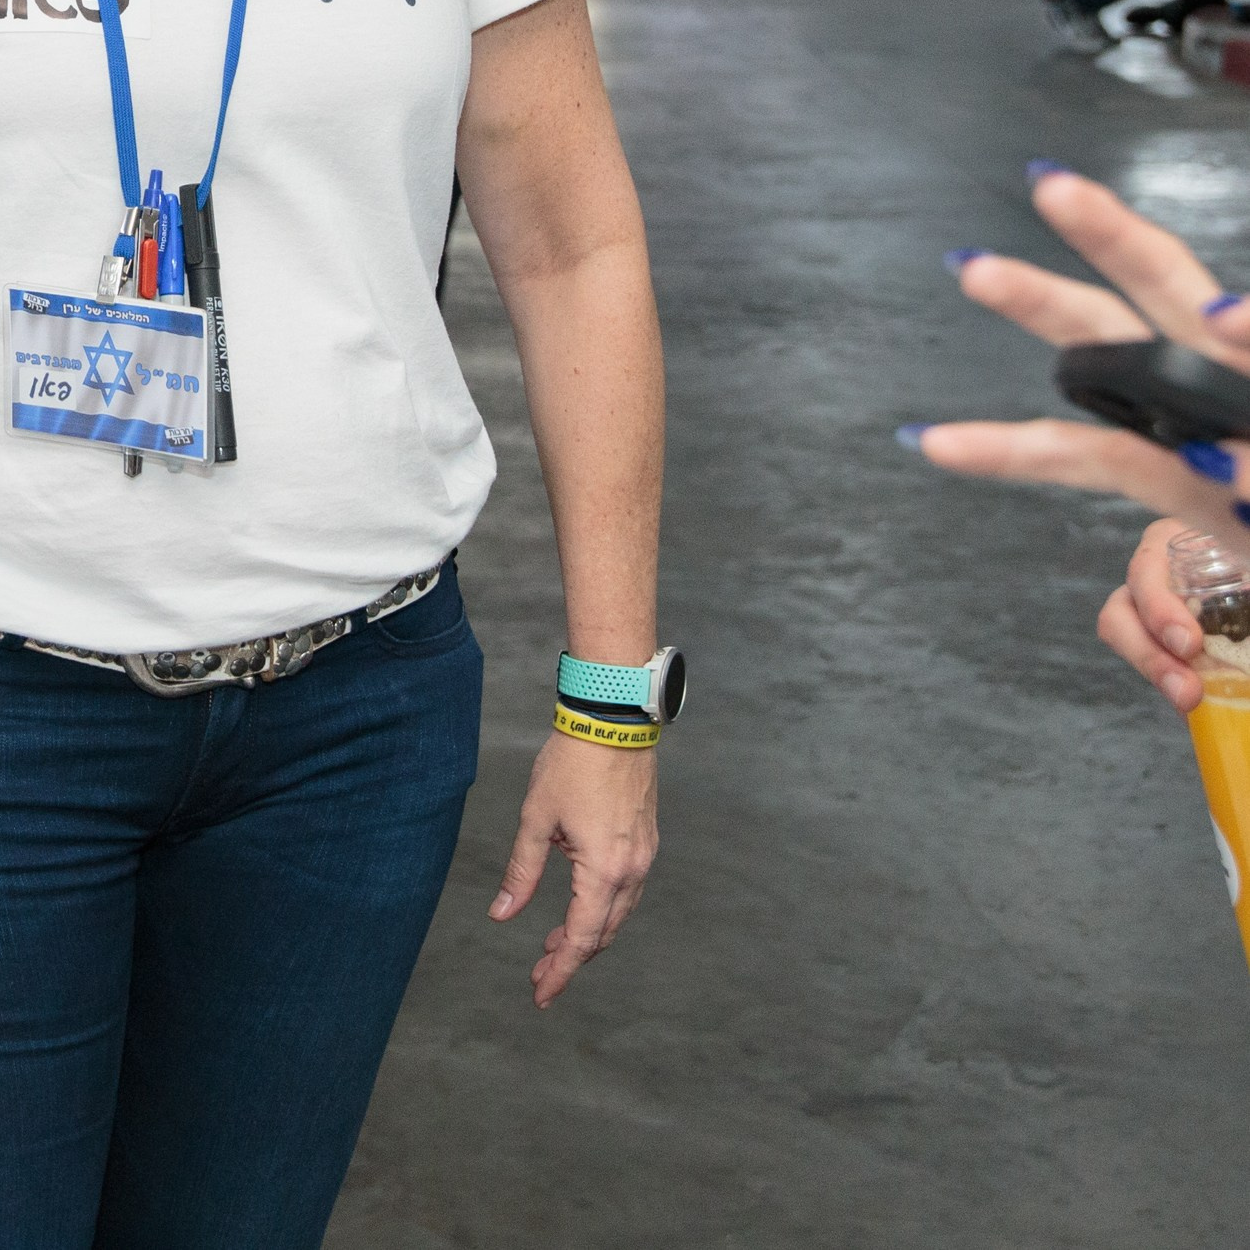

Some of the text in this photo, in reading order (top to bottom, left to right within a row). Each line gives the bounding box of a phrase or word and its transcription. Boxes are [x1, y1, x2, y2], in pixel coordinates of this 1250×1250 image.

[63, 304, 150, 323] המלאכים של ערן
[15, 351, 82, 371] מתנדבים
[221, 367, 230, 392] K30
[570, 720, 591, 735] לשון
[617, 732, 630, 743] לא
